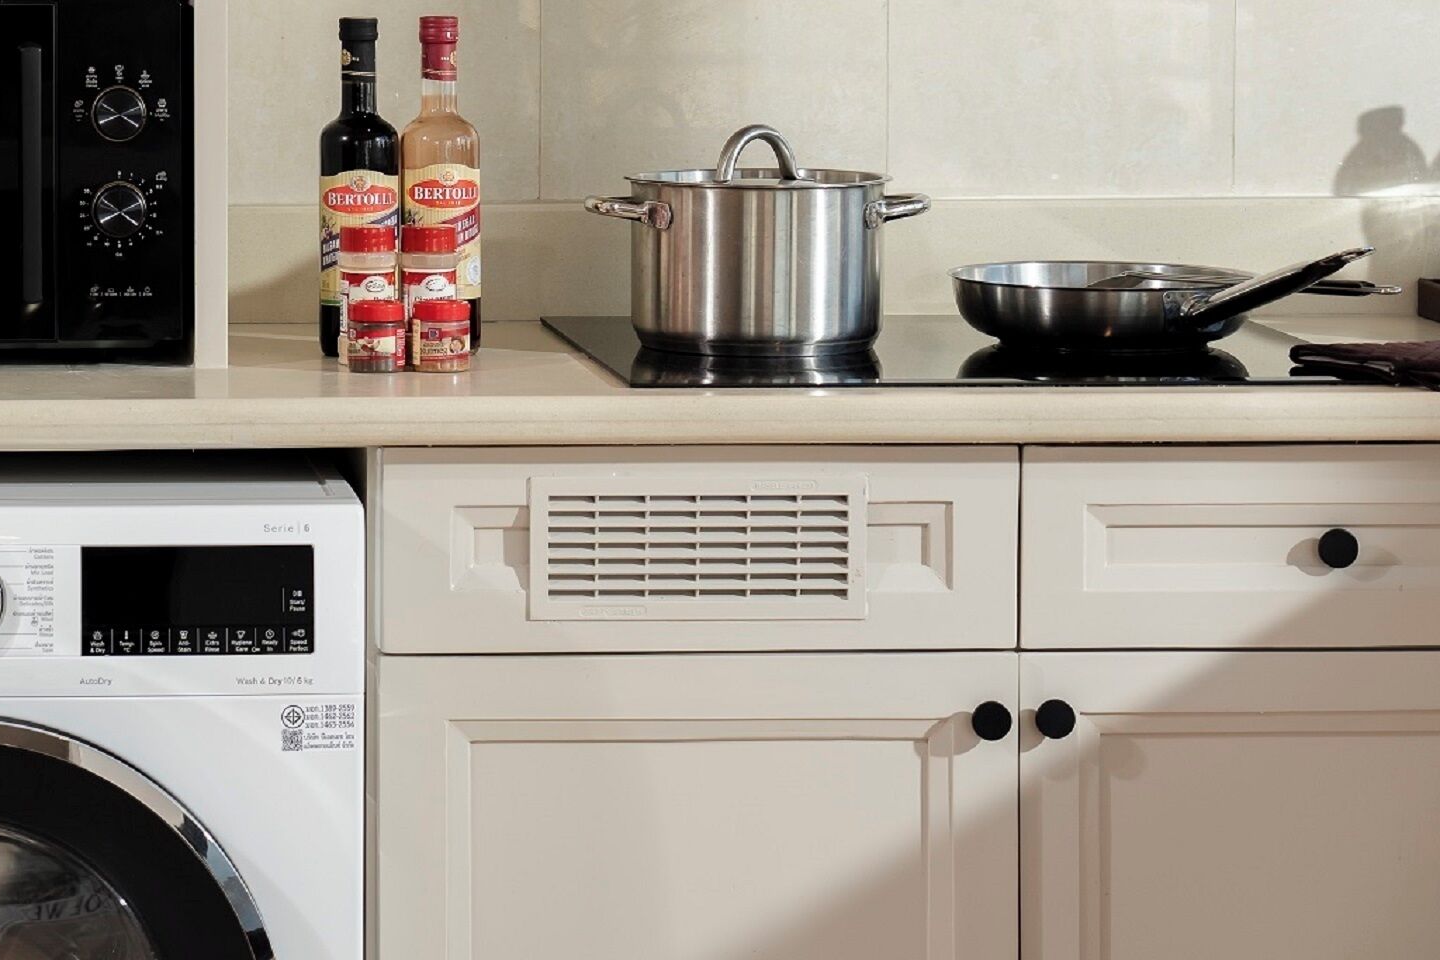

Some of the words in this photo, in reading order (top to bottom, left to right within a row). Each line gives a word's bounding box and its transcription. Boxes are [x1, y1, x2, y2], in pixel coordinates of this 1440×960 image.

[328, 191, 392, 206] BERTOLLI
[263, 523, 294, 533] Serie
[303, 523, 310, 533] 6
[79, 677, 113, 687] AutoDry
[235, 676, 259, 685] Wash
[268, 676, 283, 686] Dry
